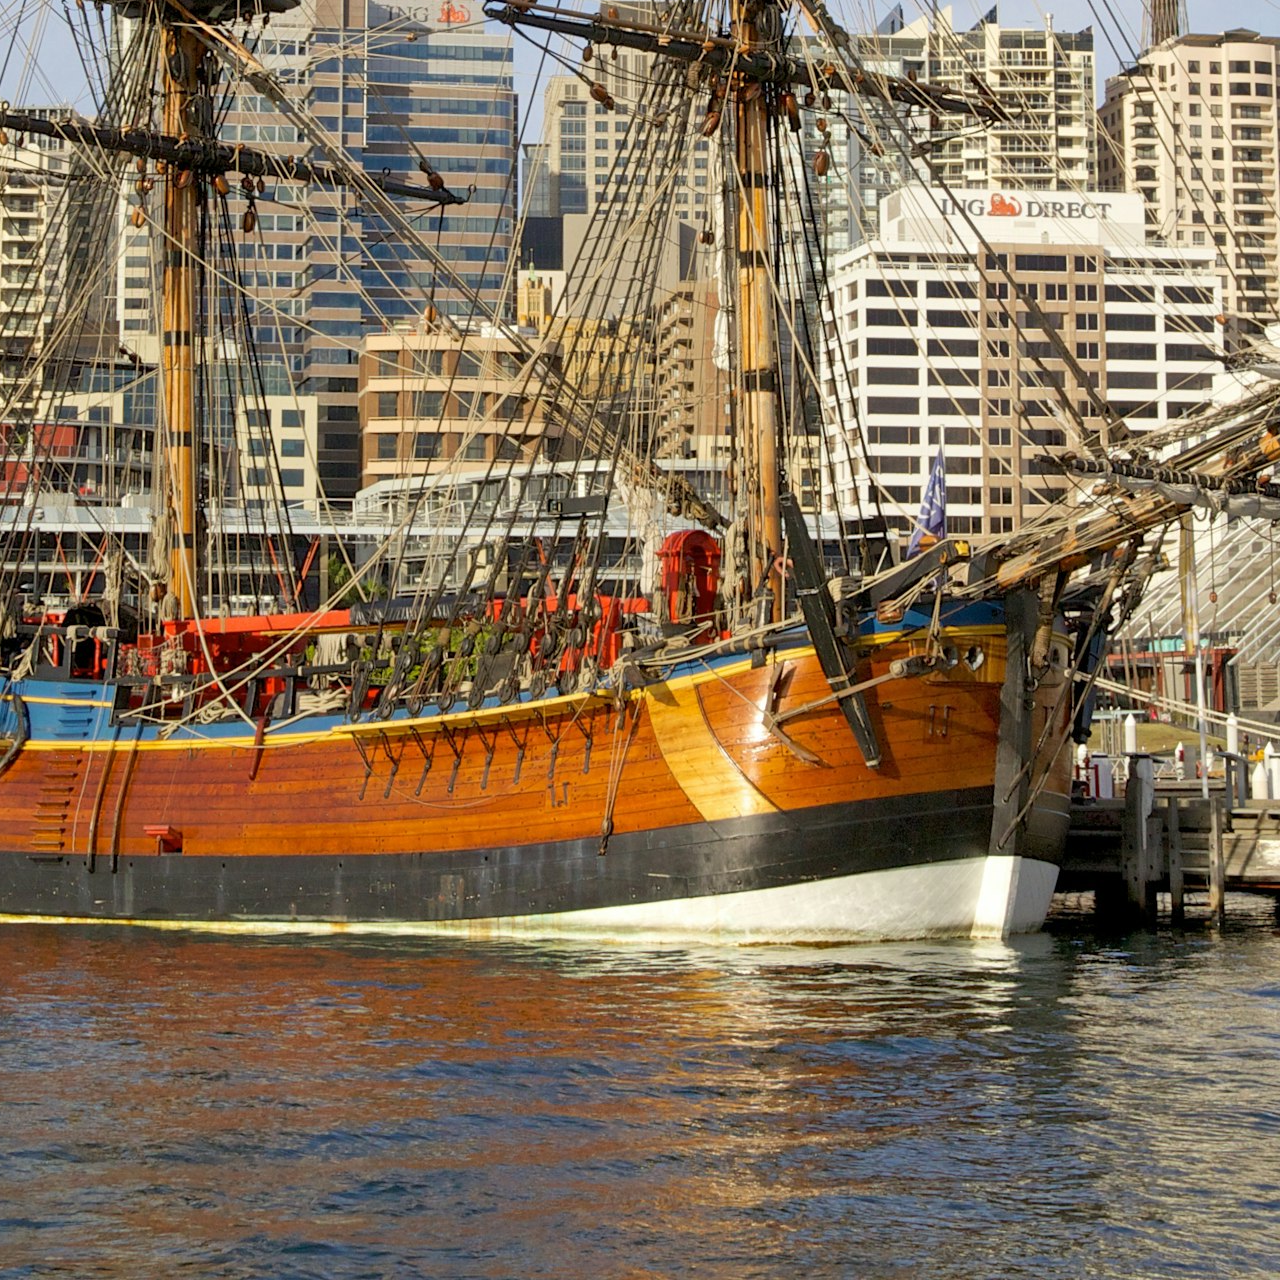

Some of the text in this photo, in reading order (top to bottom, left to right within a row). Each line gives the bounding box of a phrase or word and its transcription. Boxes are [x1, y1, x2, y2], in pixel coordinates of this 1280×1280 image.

[383, 5, 431, 23] ING
[940, 198, 1112, 219] ING DIRECT
